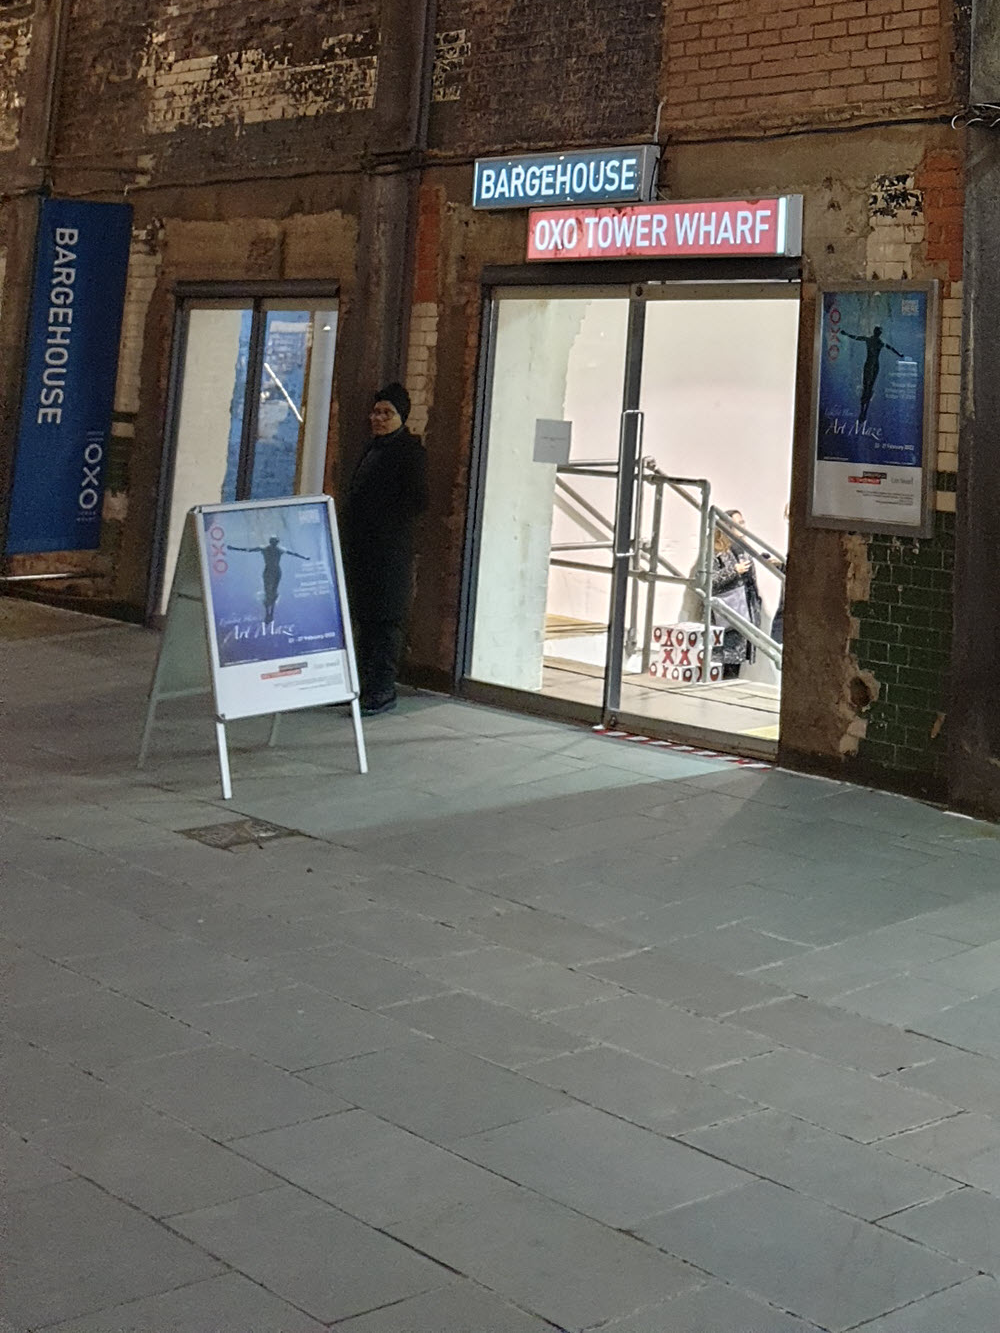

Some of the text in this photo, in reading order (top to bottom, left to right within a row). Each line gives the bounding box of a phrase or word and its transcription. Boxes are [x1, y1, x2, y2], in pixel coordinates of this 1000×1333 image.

[480, 157, 637, 200] BARGEHOUSE
[533, 209, 772, 251] OXO TOWER WHARF
[37, 227, 78, 425] BARGEHOUSE
